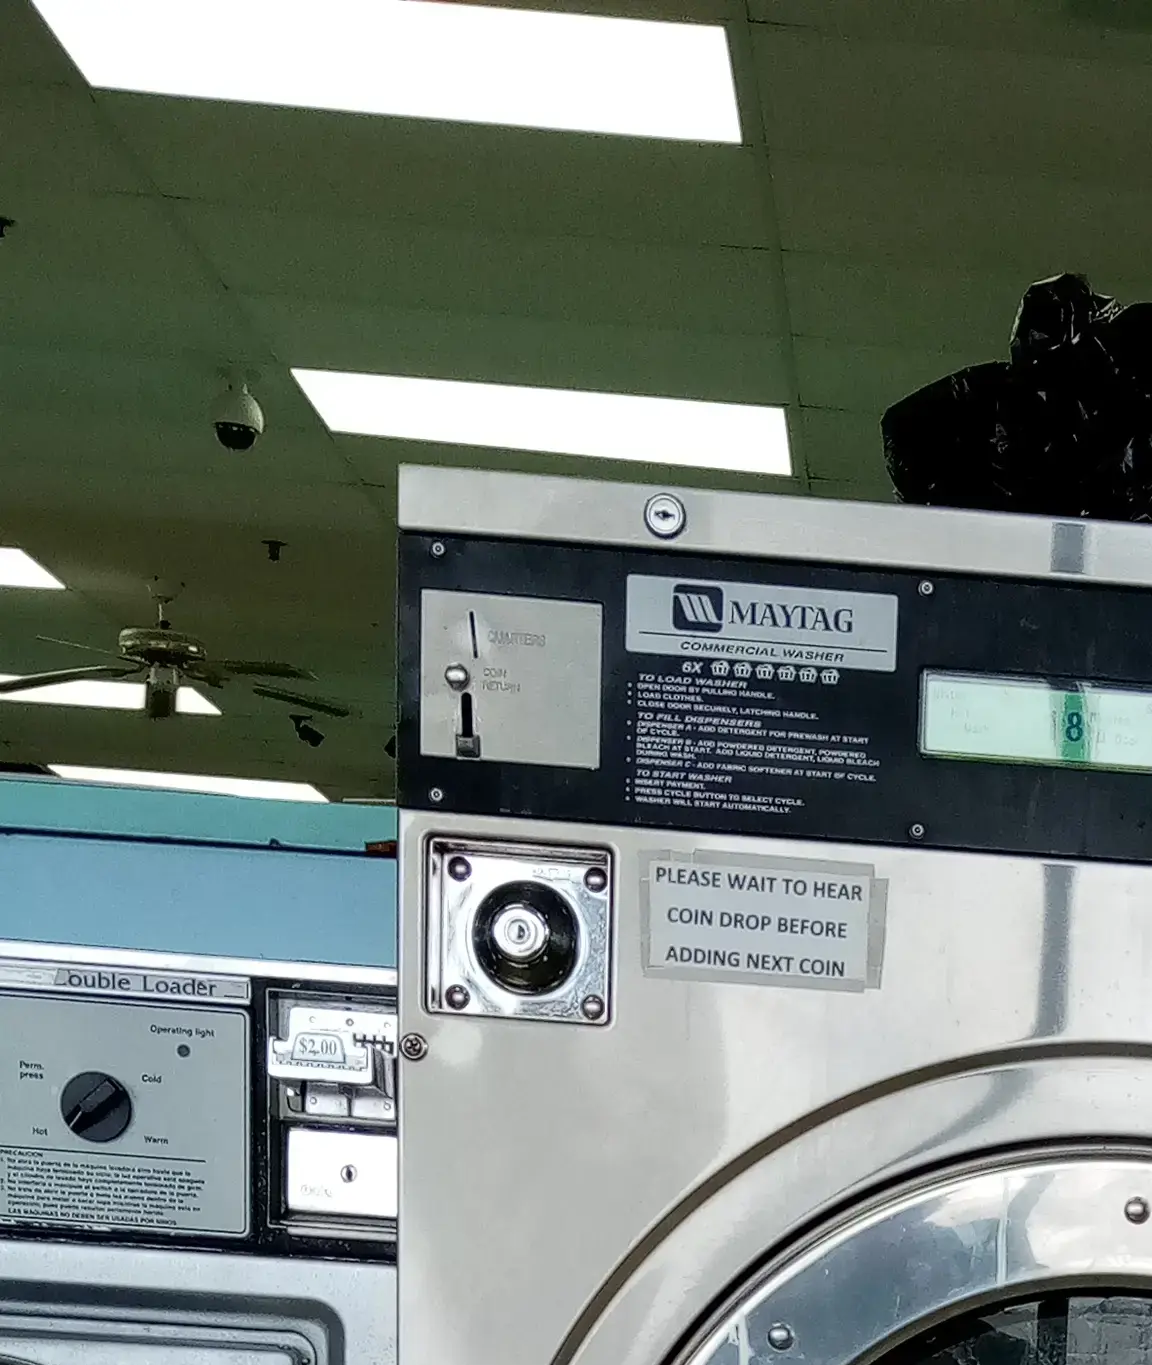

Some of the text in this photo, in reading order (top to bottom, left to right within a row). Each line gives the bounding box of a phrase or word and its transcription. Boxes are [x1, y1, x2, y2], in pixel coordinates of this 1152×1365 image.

[728, 600, 853, 633] MAYTAG
[680, 640, 845, 663] COMMERCIAL WASHER
[682, 661, 704, 674] 6X
[640, 673, 748, 689] TO LOAD WASHER
[637, 682, 776, 699] OPEN DOOR BY PULLING HANDLE.
[638, 692, 704, 703] LOAD CLOTHES.
[638, 700, 665, 709] CLOSE
[667, 703, 692, 711] DOOR
[740, 708, 780, 717] LATCHING
[782, 711, 819, 720] HANDLE.
[638, 712, 762, 728] TO FILL DISPENSERS
[1065, 711, 1084, 742] 8
[636, 721, 684, 731] DISPENSER
[698, 725, 716, 733] ADD
[718, 727, 768, 737] DETERGENT
[788, 732, 829, 741] PREWASH
[842, 736, 869, 744] START
[650, 729, 680, 737] CYCLE.
[636, 736, 684, 746] DISPENSER
[697, 740, 716, 748] ADD
[717, 742, 765, 752] POWDERED
[636, 743, 670, 751] BLEACH
[715, 748, 734, 756] ADD
[736, 750, 762, 758] LIQUID
[817, 756, 844, 764] LIQUID
[845, 758, 880, 767] BLEACH
[636, 758, 683, 768] DISPENSER
[696, 762, 714, 770] ADD
[716, 763, 746, 772] FABRIC
[748, 766, 792, 775] SOFTENER
[806, 770, 832, 778] START
[847, 773, 876, 781] CYCLE.
[636, 769, 733, 783] TO START WASHER
[635, 779, 706, 790] INSERT PAYMENT.
[634, 787, 662, 796] PRESS
[664, 789, 692, 798] CYCLE
[693, 791, 728, 800] BUTTON
[742, 795, 774, 804] SELECT
[774, 797, 806, 806] CYCLE.
[635, 796, 671, 805] WASHER
[694, 800, 720, 808] START
[722, 802, 792, 814] AUTOMATICALLY.
[656, 866, 863, 901] PLEASE WAIT TO HEAR
[667, 907, 847, 938] COIN DROP BEFORE
[666, 946, 844, 977] ADDING NEXT COIN
[66, 970, 217, 997] ouble Loader
[150, 1024, 215, 1038] Operating light
[298, 1039, 337, 1056] $2.00
[20, 1060, 44, 1070] Perm.
[20, 1072, 44, 1080] press
[142, 1074, 162, 1084] Cold
[32, 1127, 48, 1136] Hot
[144, 1136, 169, 1145] Warm
